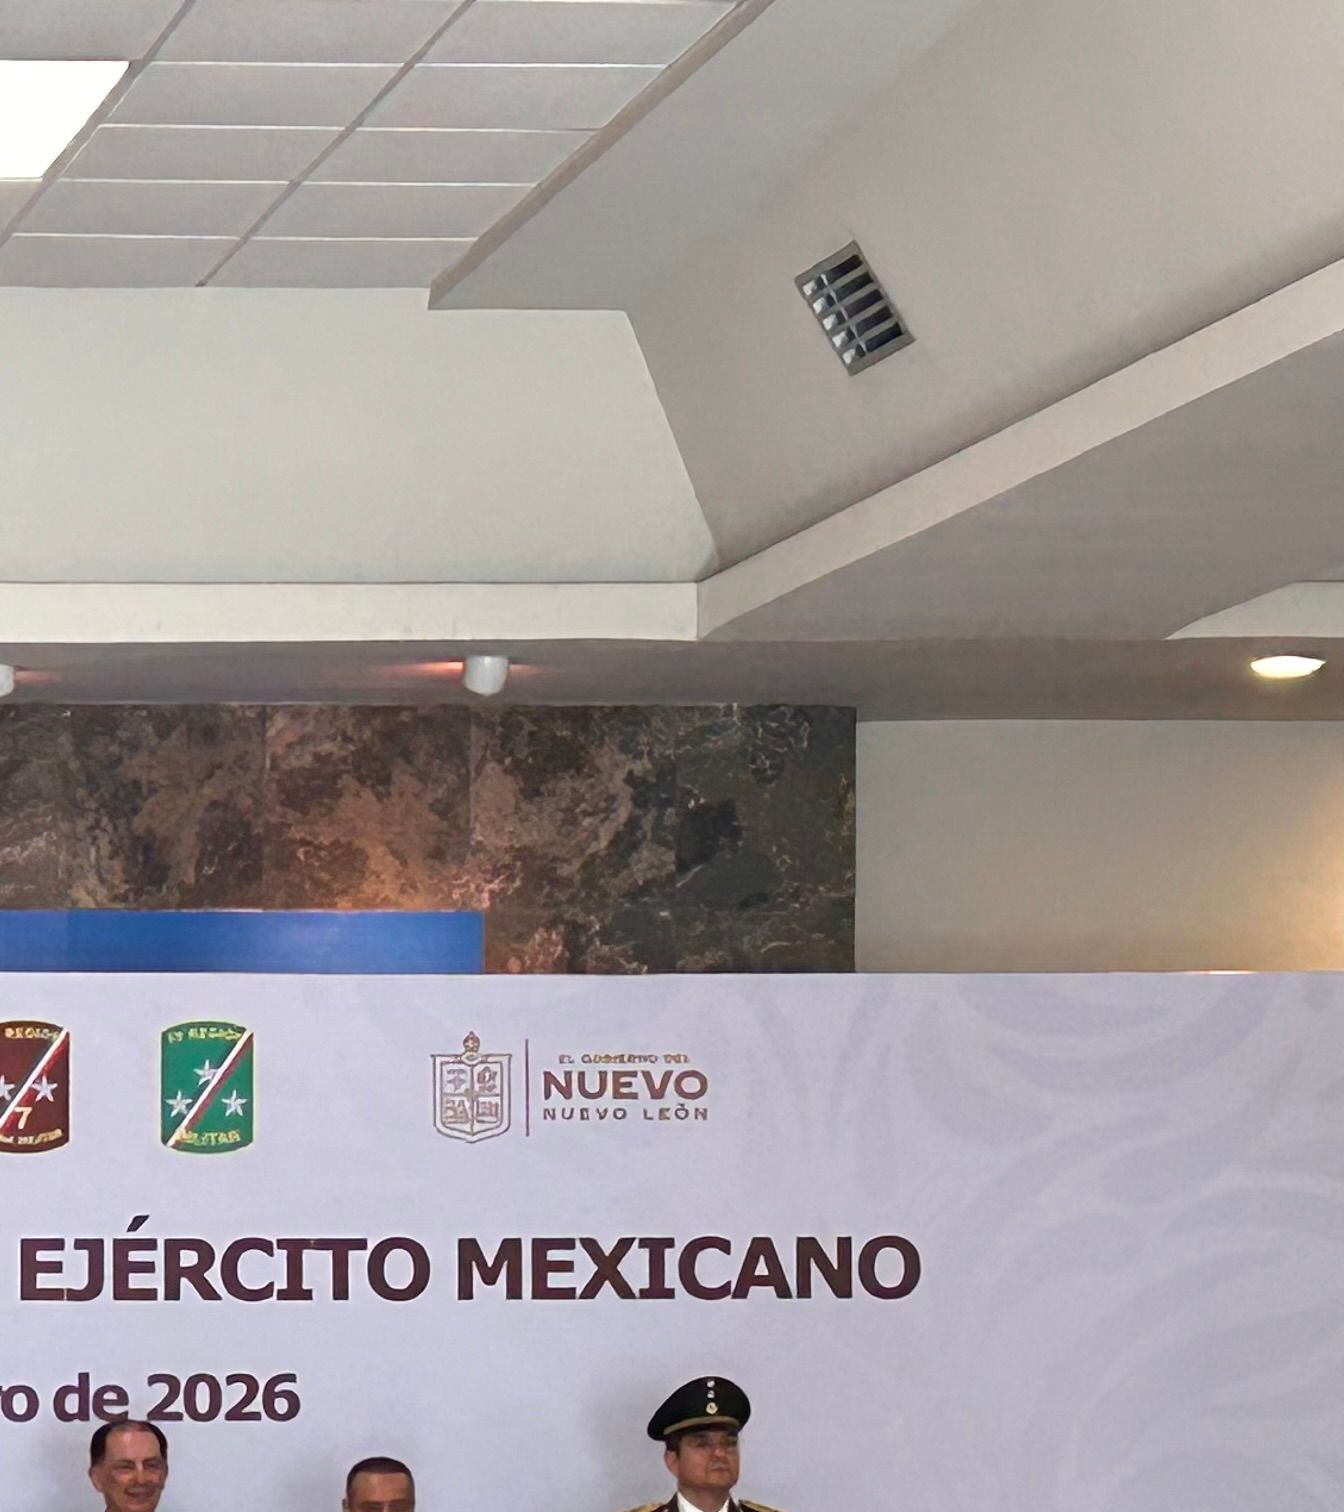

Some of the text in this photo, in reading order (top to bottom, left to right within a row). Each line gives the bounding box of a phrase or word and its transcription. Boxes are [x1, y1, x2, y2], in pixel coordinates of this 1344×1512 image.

[543, 1069, 709, 1101] NUEVO
[14, 1105, 33, 1130] 7
[543, 1102, 709, 1122] NUEVO LEÓN
[20, 1214, 431, 1303] EJÉRCITO
[457, 1234, 922, 1303] MEXICANO
[53, 1371, 129, 1423] de
[146, 1373, 302, 1423] 2026
